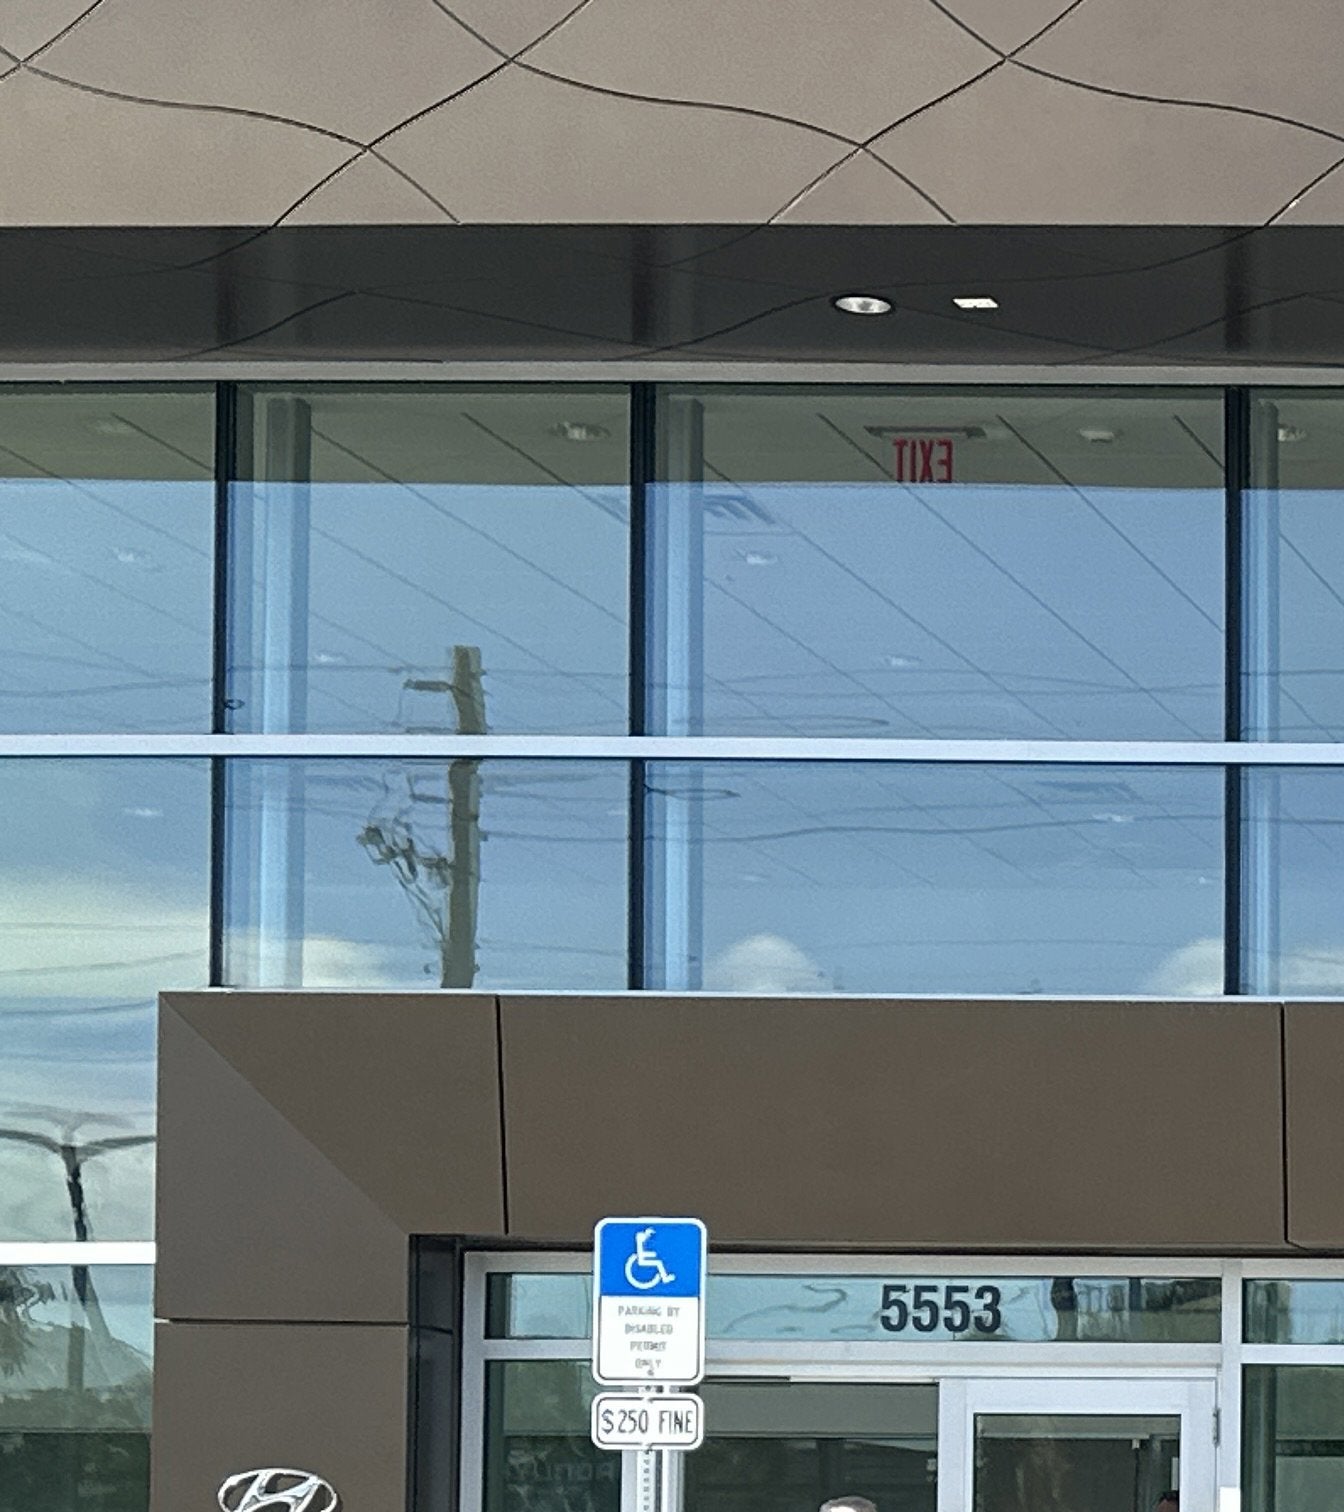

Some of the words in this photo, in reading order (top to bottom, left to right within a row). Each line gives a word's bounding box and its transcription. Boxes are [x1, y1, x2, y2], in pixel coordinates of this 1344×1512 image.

[617, 1305, 662, 1317] PARKING
[881, 1284, 1001, 1332] 5553
[624, 1323, 674, 1335] DISABLED
[601, 1408, 649, 1435] $250
[658, 1410, 694, 1434] FINE
